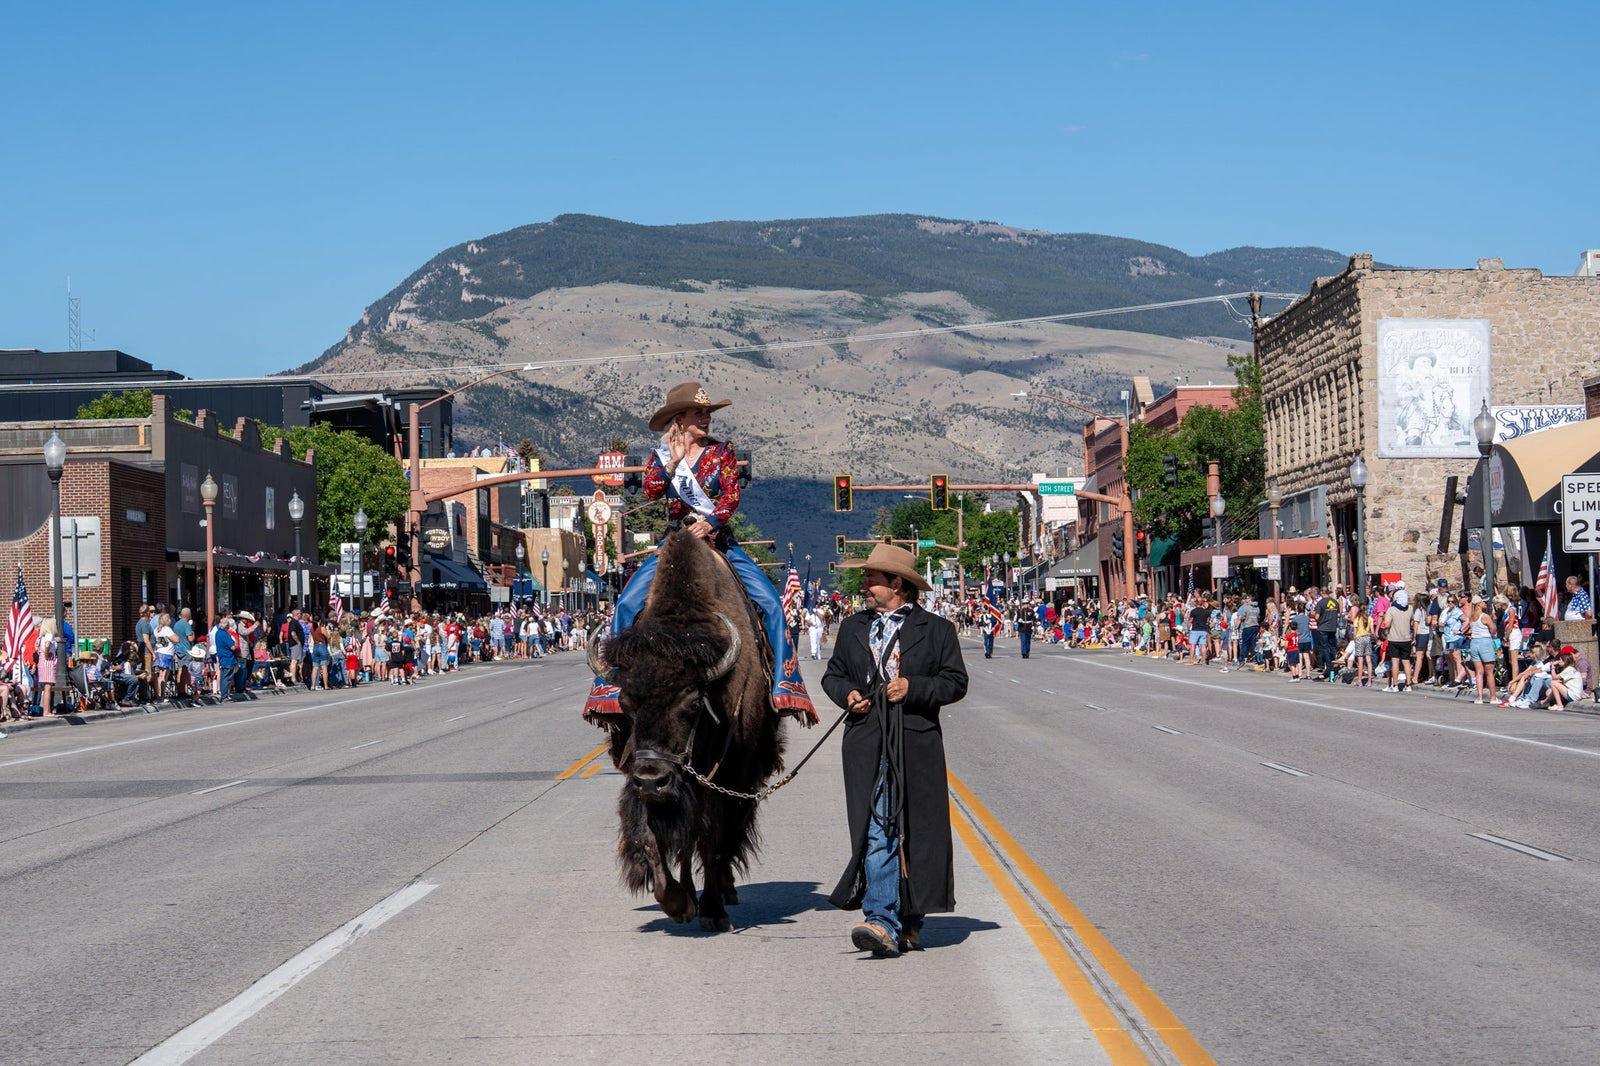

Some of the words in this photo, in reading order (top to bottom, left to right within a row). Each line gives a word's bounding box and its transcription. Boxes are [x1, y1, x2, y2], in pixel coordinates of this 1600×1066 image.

[1496, 407, 1586, 441] SILVE
[1039, 485, 1052, 493] 13TH
[1053, 485, 1073, 493] STREET
[1570, 519, 1600, 543] 2
